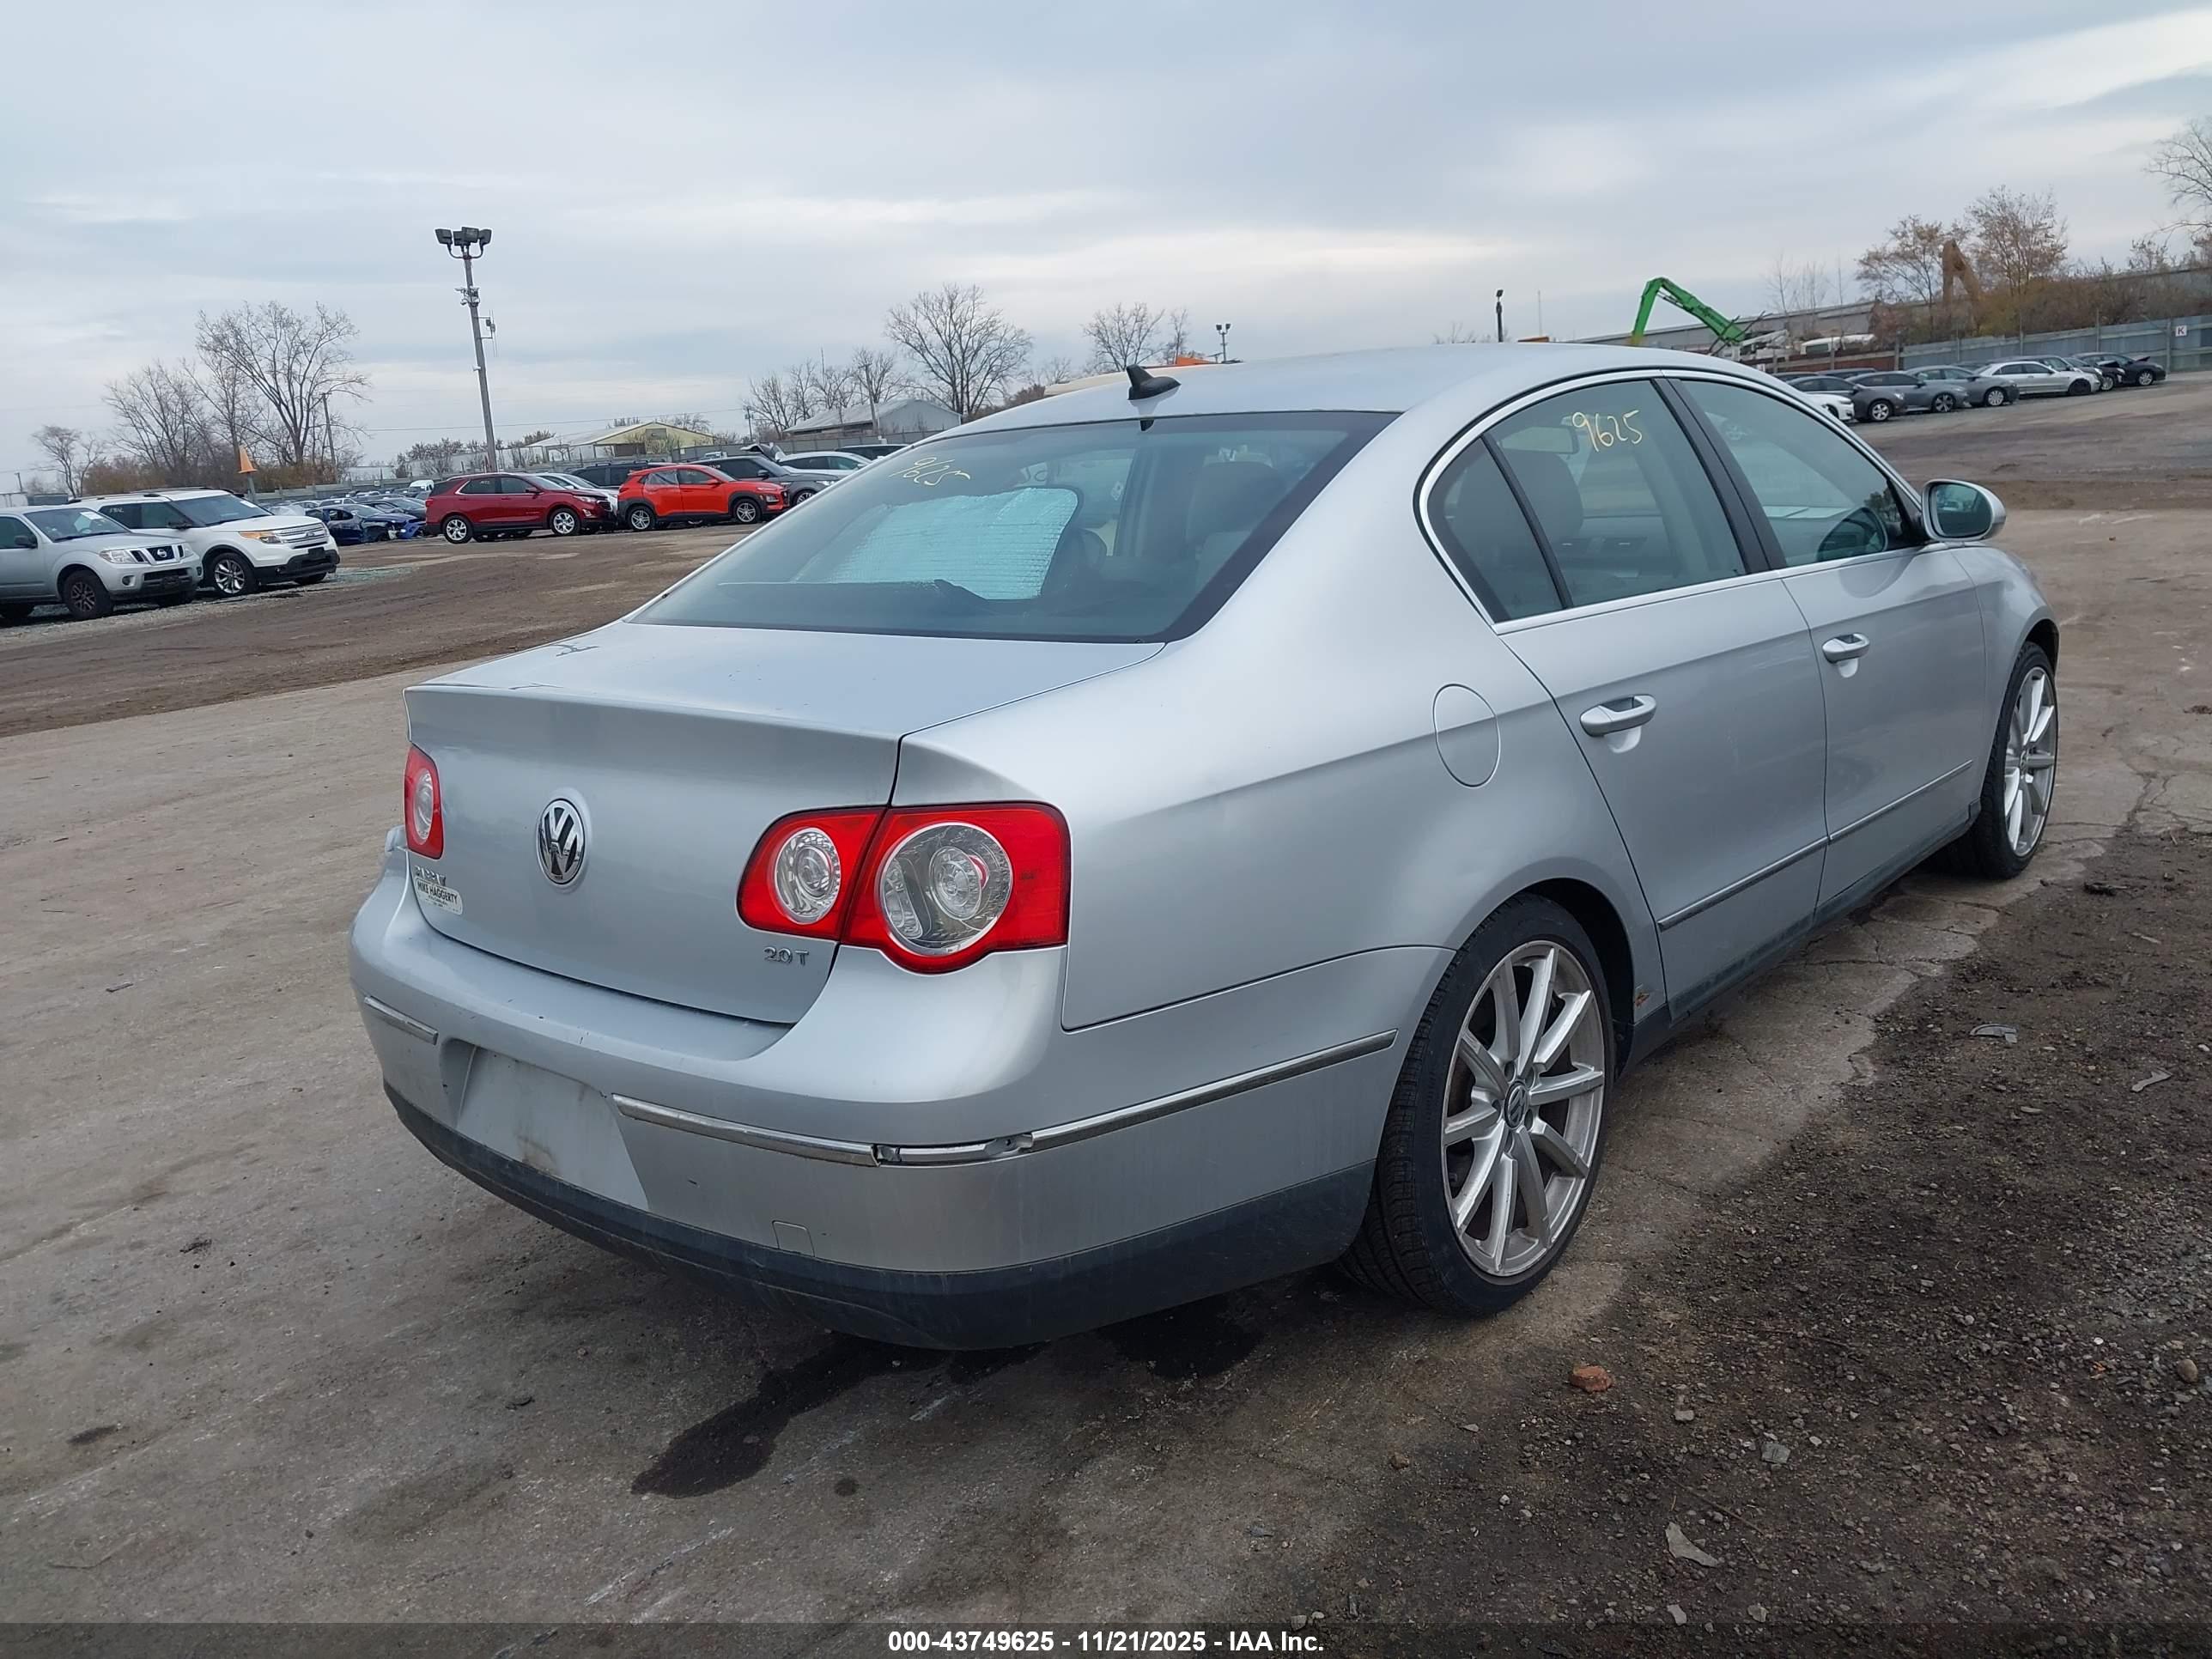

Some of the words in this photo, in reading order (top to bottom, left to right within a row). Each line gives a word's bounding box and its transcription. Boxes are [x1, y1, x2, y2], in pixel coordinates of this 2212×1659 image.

[2177, 326, 2185, 335] K
[1572, 410, 1643, 453] 9625
[888, 457, 971, 486] 9625
[416, 879, 429, 894] MIKE
[429, 885, 458, 904] HAGGERTY
